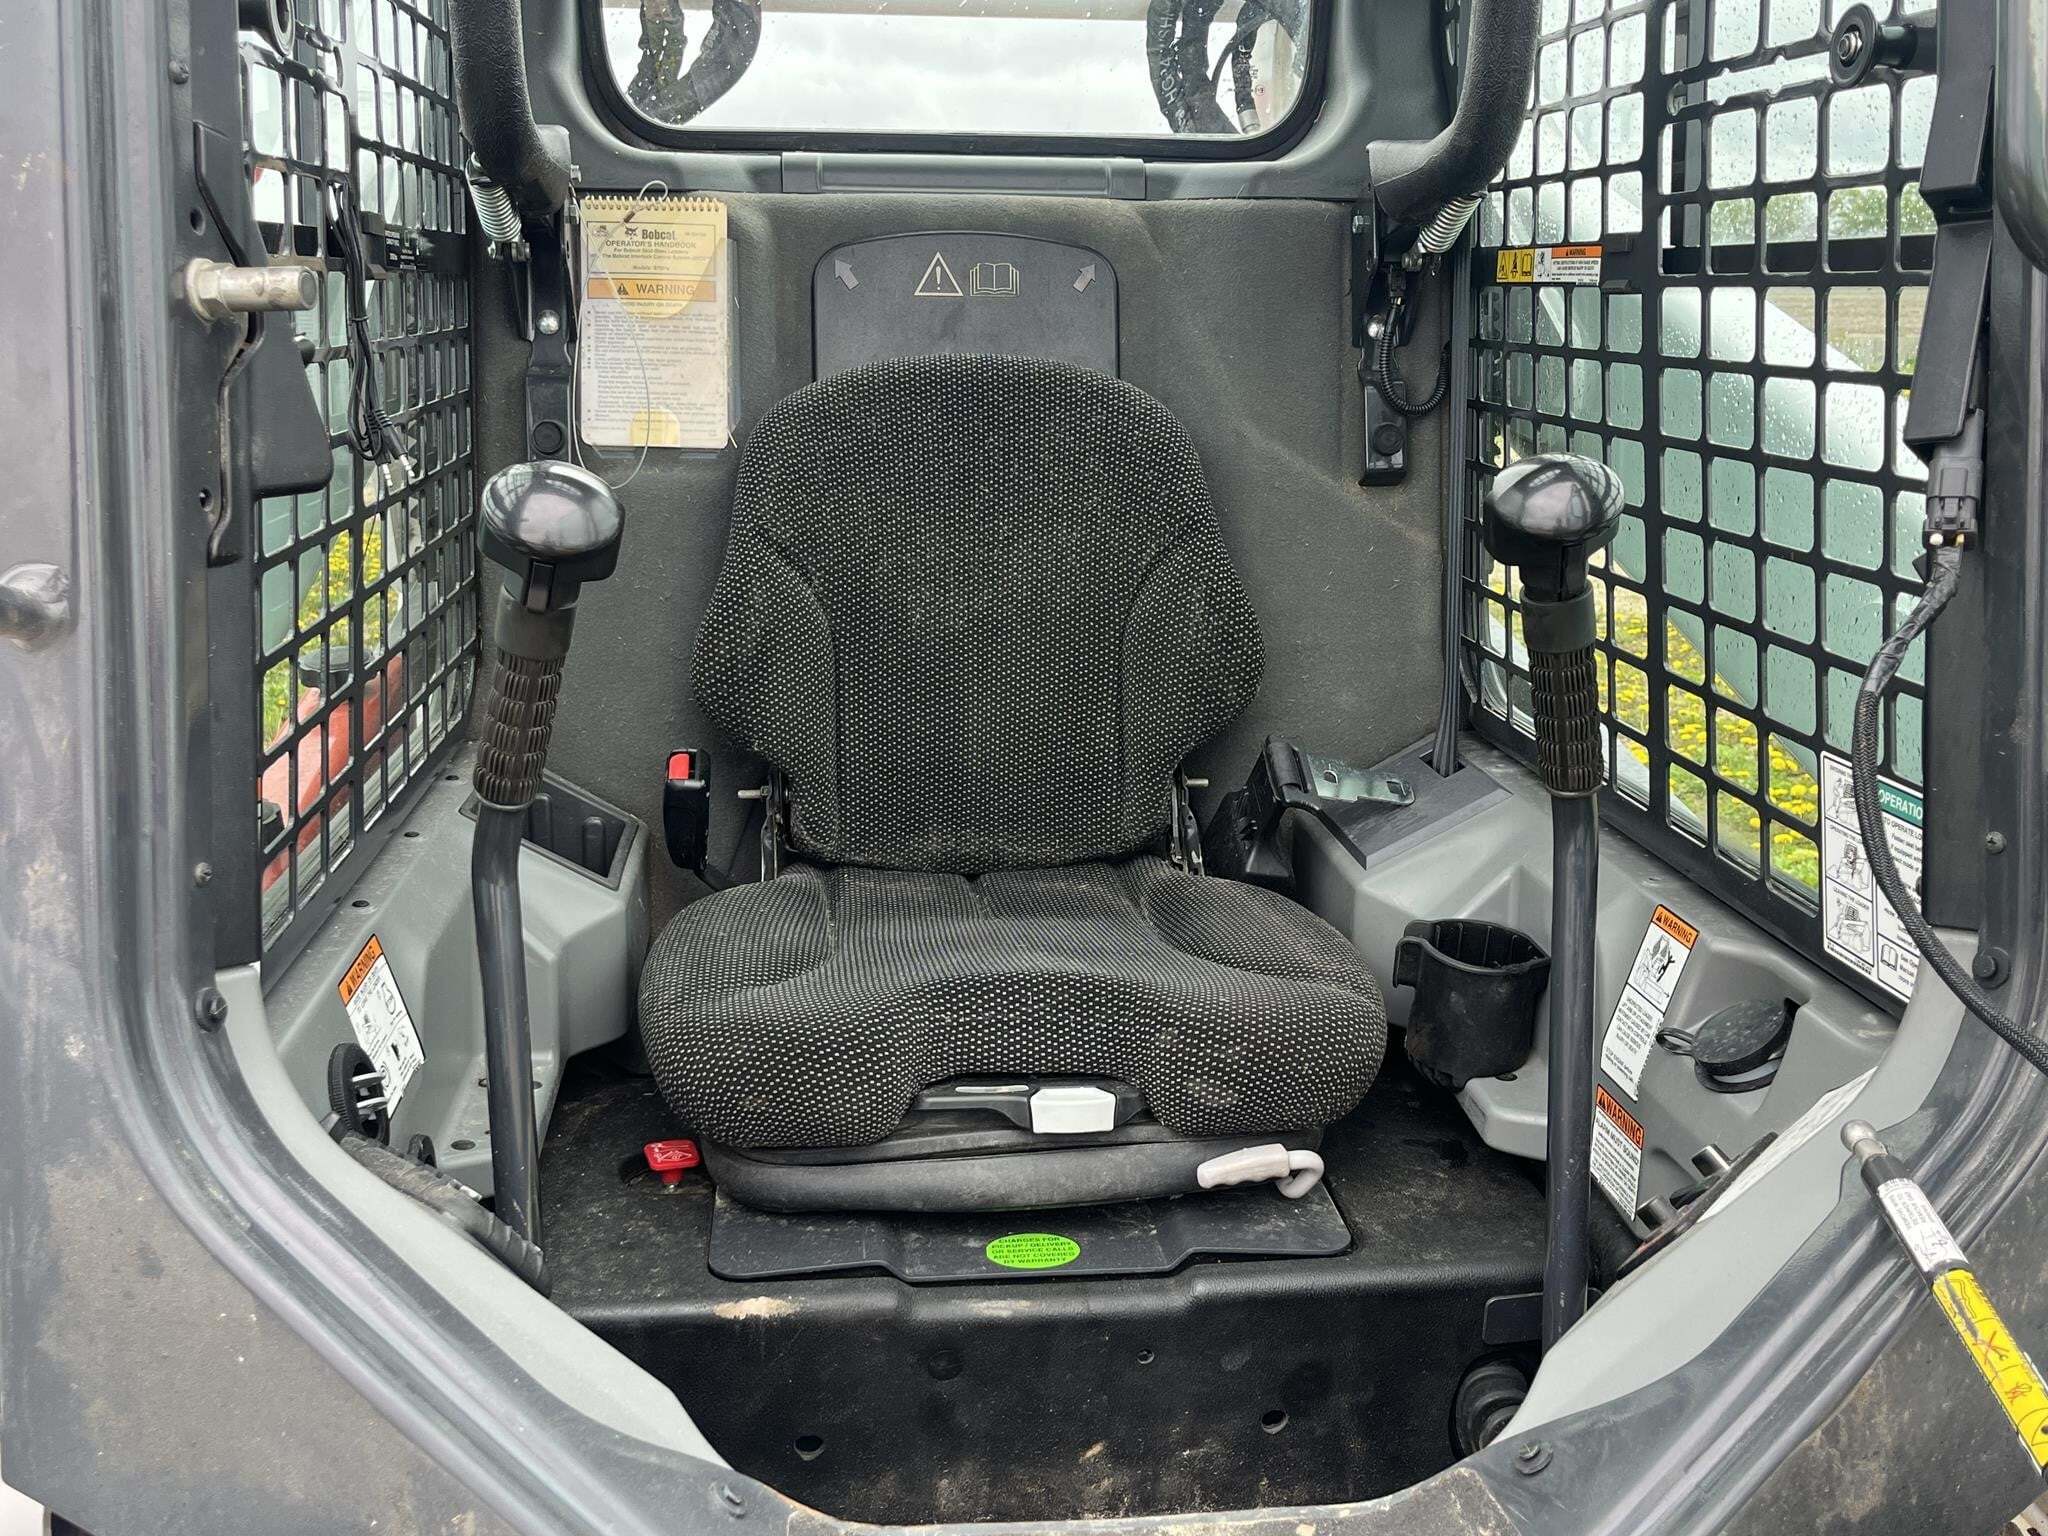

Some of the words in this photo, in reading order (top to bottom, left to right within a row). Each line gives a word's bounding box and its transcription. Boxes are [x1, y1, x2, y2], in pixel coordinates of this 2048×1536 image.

[642, 229, 676, 240] Bobcat
[654, 241, 696, 249] HANDBOOK
[636, 283, 695, 295] WARNING
[1878, 789, 1923, 820] OPERATIO
[1892, 821, 1914, 836] OPERATE
[1662, 914, 1693, 943] WARNING
[350, 946, 377, 989] WARNING
[1606, 1098, 1642, 1147] WARNING
